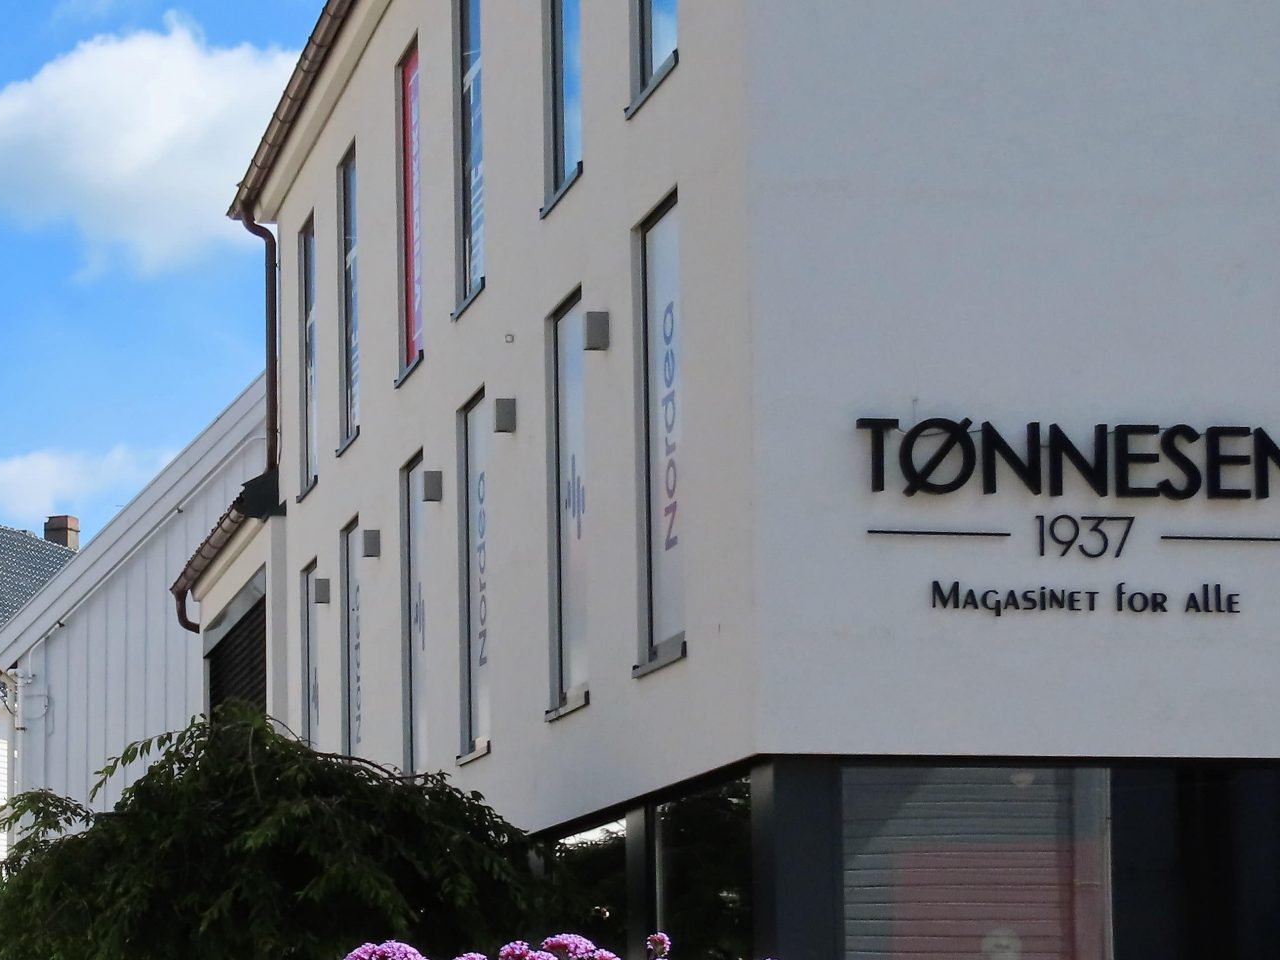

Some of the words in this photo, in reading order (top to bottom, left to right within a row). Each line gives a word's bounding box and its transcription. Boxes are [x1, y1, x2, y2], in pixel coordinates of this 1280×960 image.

[661, 301, 678, 551] Nordea
[477, 471, 488, 667] Nordea
[1035, 514, 1135, 558] 1937
